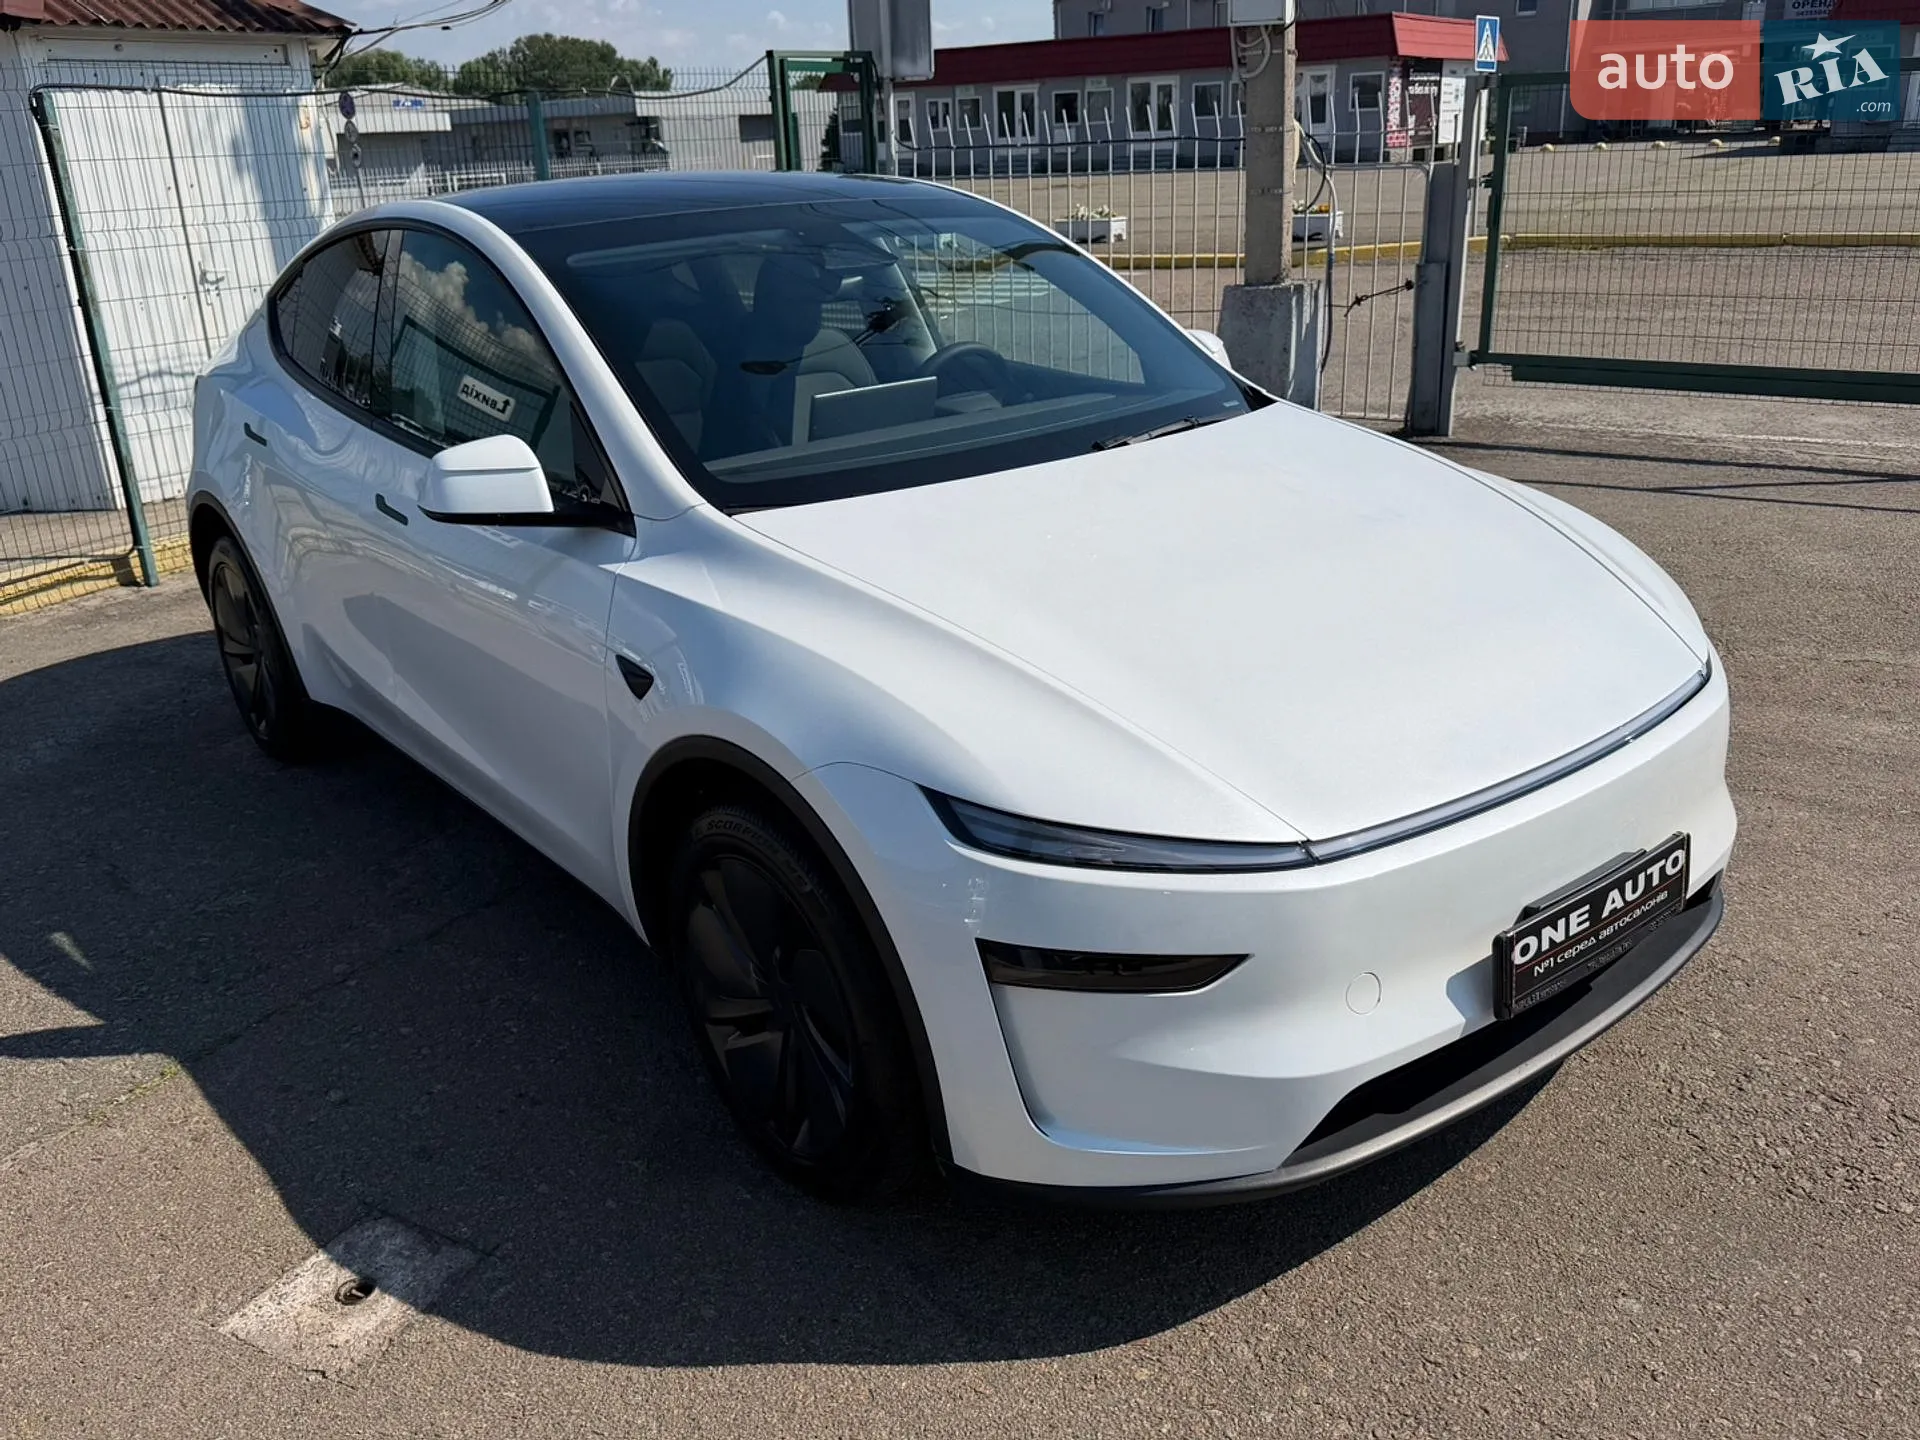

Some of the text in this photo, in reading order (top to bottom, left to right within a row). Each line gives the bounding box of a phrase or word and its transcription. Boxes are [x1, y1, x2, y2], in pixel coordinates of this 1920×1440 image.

[1512, 904, 1591, 966] ONE
[1601, 849, 1686, 920] AUTO
[1557, 937, 1596, 963] серед
[1598, 890, 1669, 940] автосалонів
